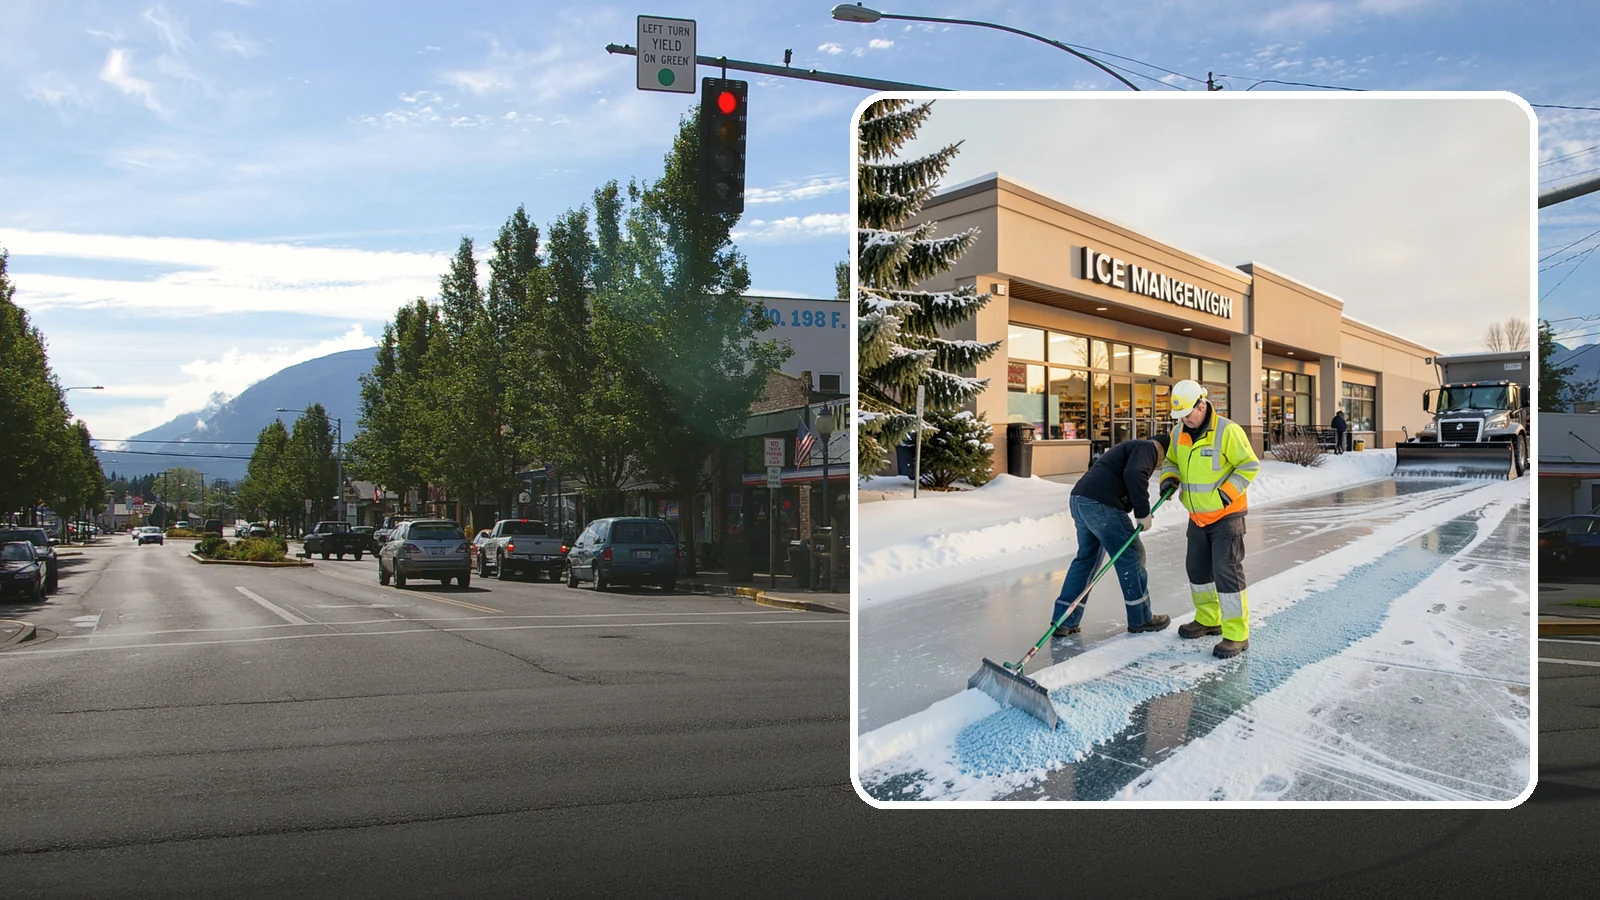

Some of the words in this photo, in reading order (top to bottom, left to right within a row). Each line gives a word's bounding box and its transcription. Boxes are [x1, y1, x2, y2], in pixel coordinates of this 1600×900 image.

[643, 24, 663, 34] LEFT
[668, 26, 690, 36] TURN
[652, 38, 682, 52] YIELD
[644, 53, 656, 64] ON
[661, 55, 689, 66] GREEN
[1081, 246, 1125, 289] ICE
[791, 309, 826, 328] 198
[831, 311, 846, 329] F.
